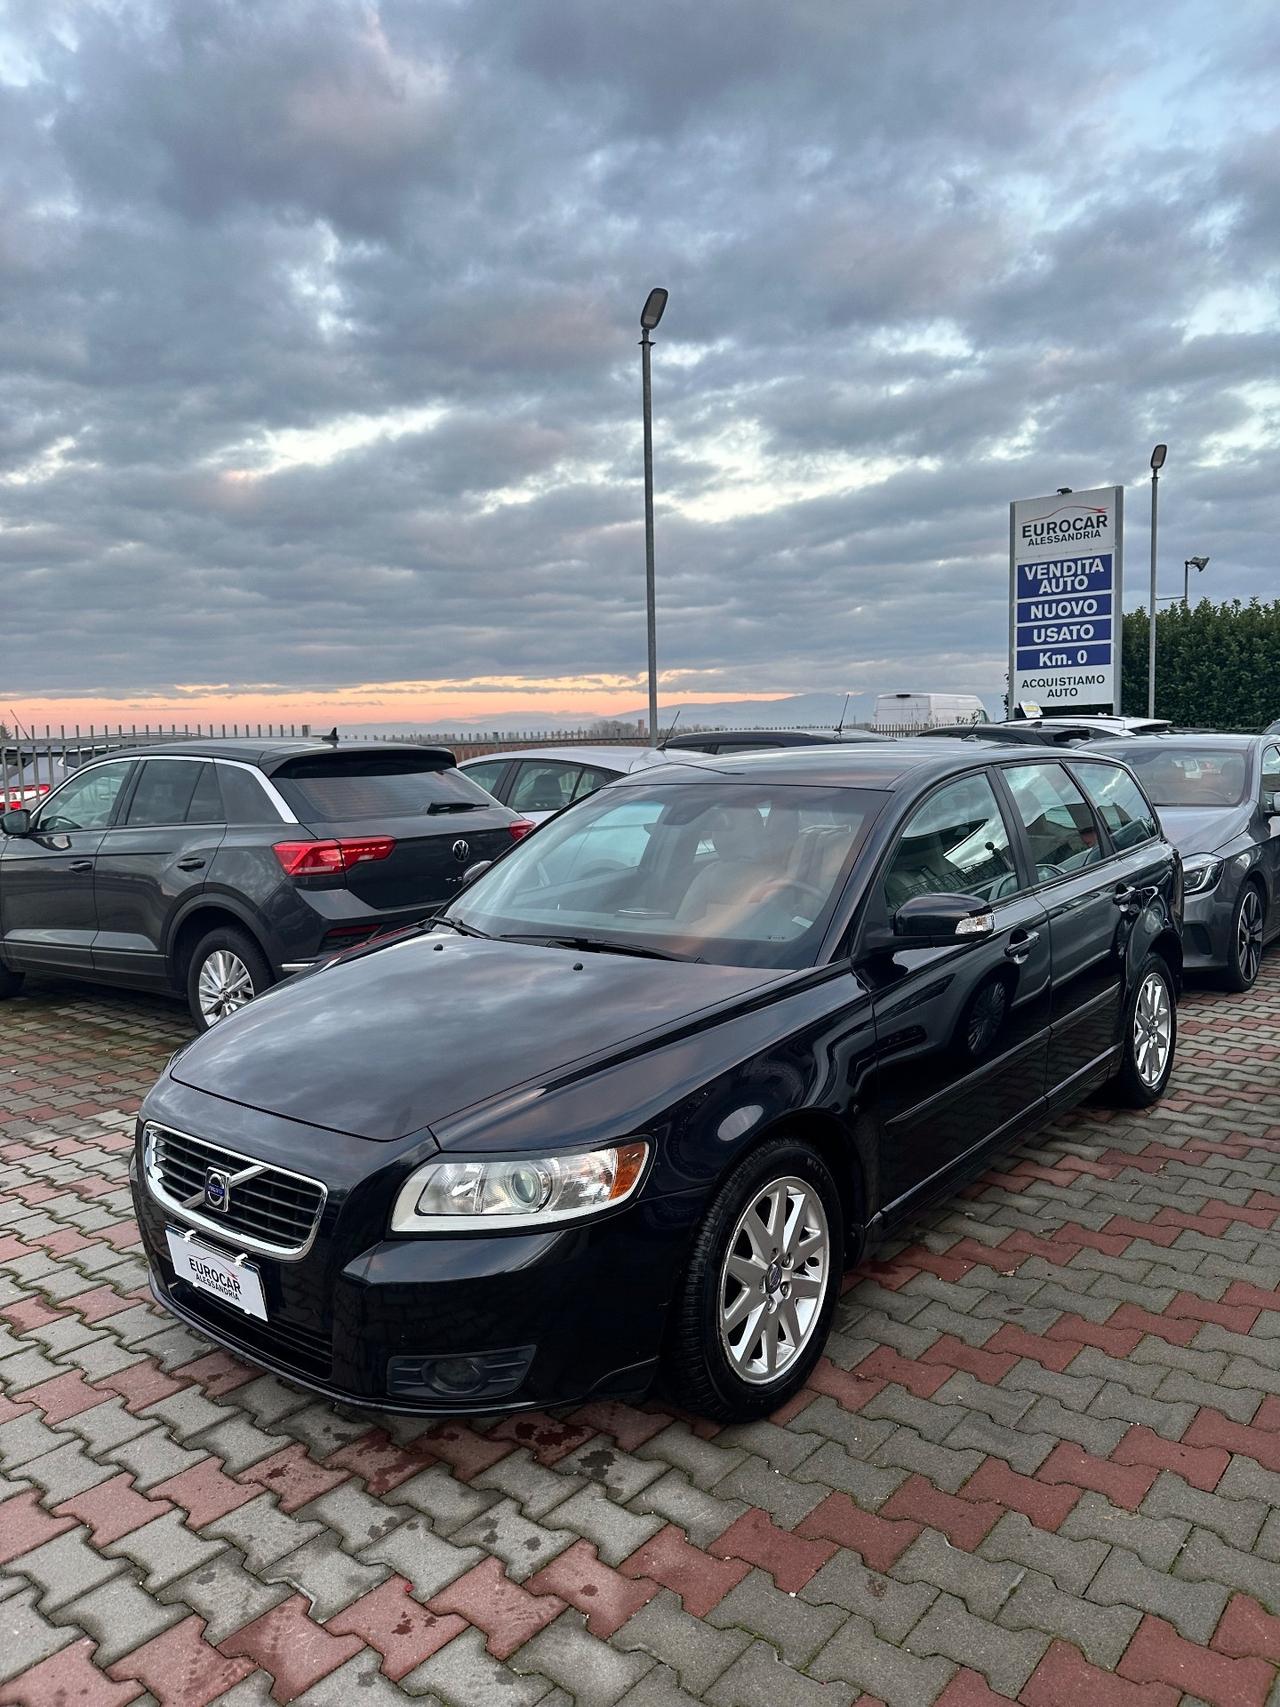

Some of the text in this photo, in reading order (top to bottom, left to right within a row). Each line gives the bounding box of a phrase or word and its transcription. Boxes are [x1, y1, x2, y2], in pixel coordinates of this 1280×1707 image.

[1022, 514, 1108, 538] EUROCAR
[1027, 529, 1101, 546] ALESSANDRIA
[1024, 557, 1104, 580] VENDITA
[1038, 574, 1089, 594] AUTO
[1030, 598, 1098, 619] NUOVO
[1033, 623, 1095, 643] USATO
[1039, 649, 1088, 667] Km. 0
[1021, 674, 1105, 689] ACQUISTIAMO
[1046, 687, 1078, 698] AUTO
[188, 1257, 242, 1295] EUROCAR
[196, 1273, 241, 1302] ALESSANDRIA
